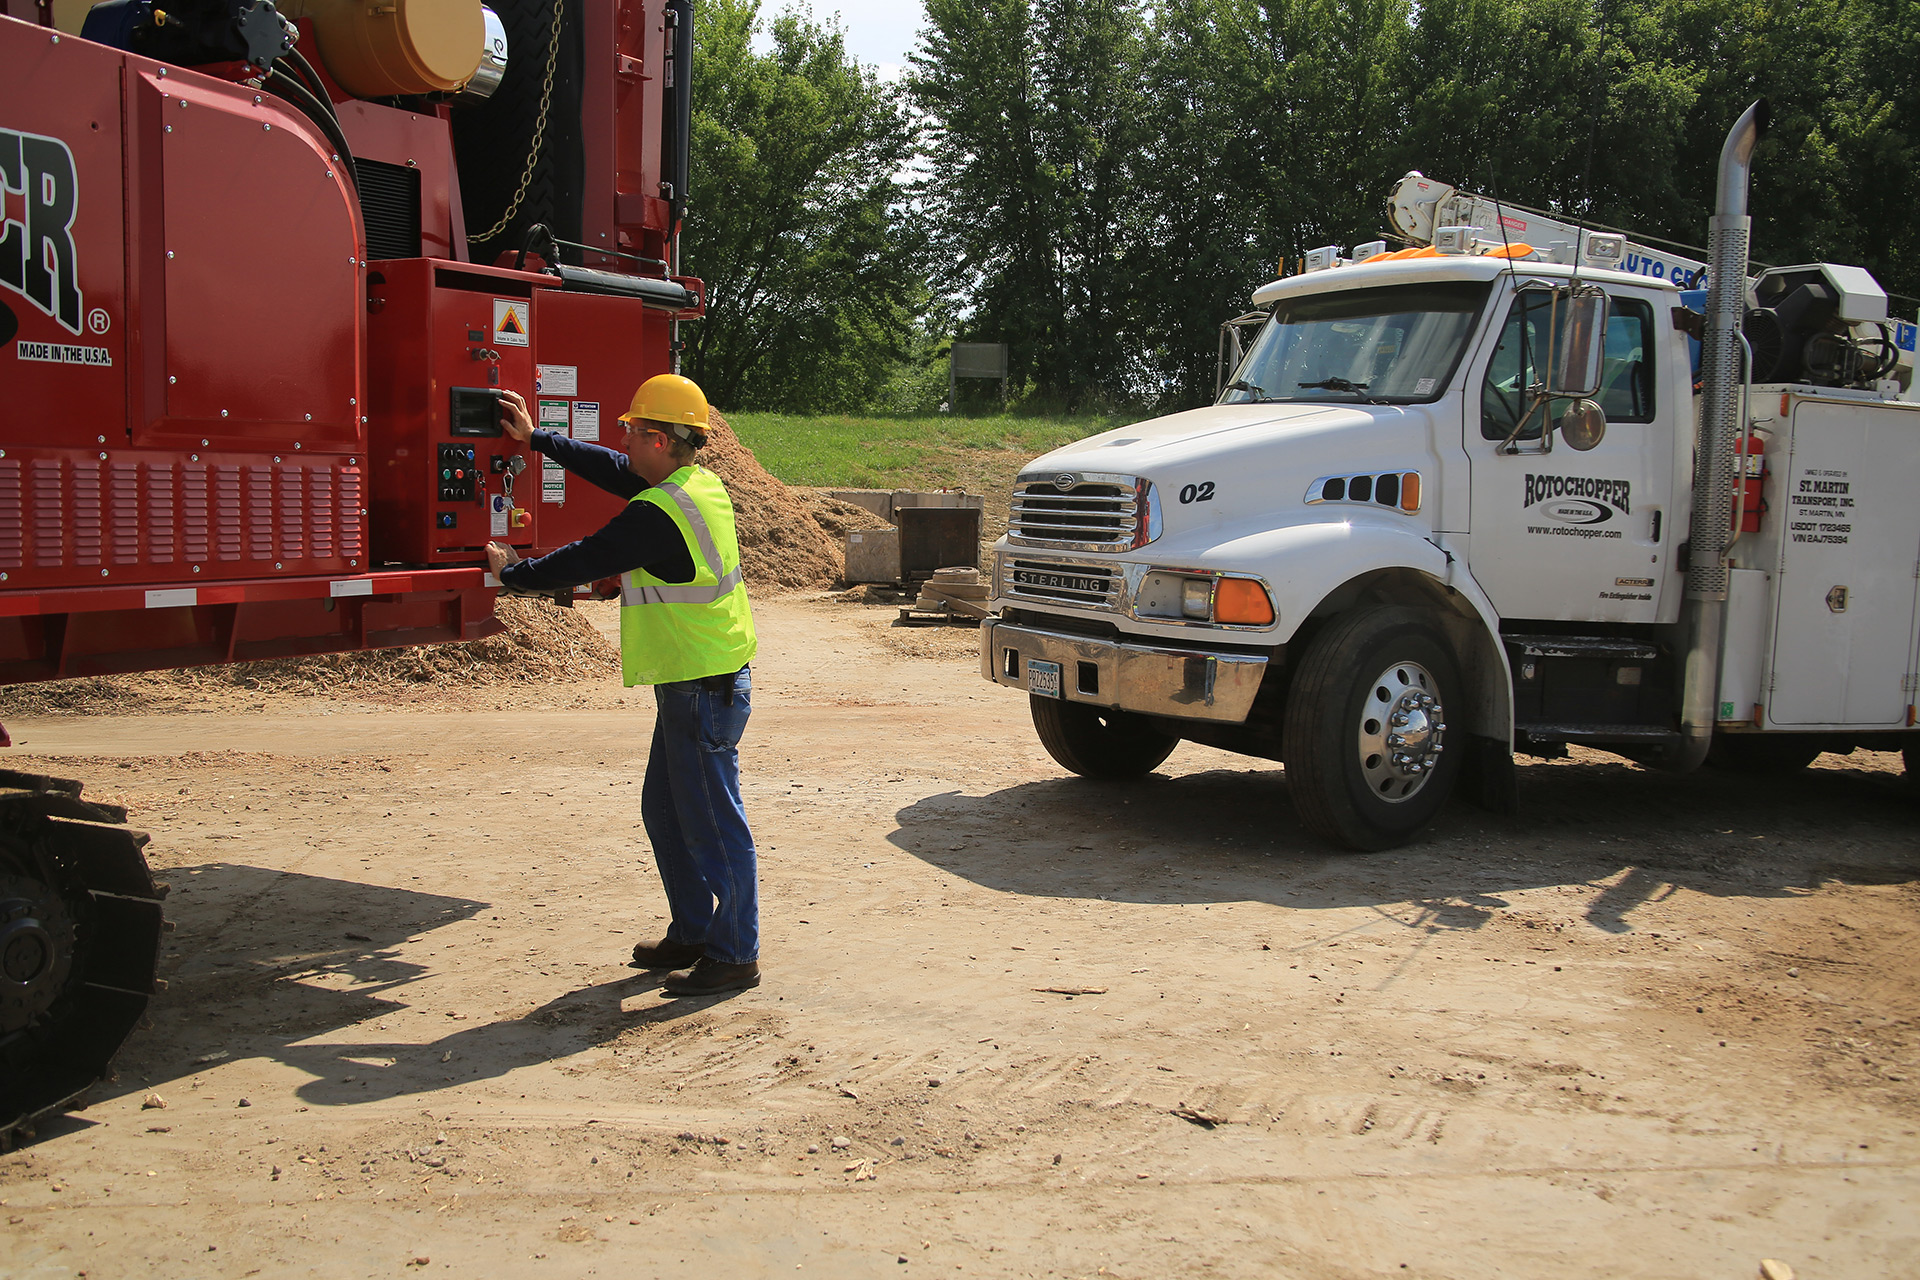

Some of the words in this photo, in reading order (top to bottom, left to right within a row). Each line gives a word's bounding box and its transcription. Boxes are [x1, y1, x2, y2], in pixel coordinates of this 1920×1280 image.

[19, 343, 49, 359] MADE
[51, 345, 62, 361] IN
[64, 347, 82, 362] THE
[85, 349, 111, 364] U.S.A.
[1179, 481, 1216, 505] 02
[1800, 480, 1812, 493] ST.
[1813, 480, 1850, 494] MARTIN
[1523, 473, 1631, 516] ROTOCHOPPER
[1792, 495, 1838, 508] TRANSPORT,
[1840, 498, 1855, 507] INC.
[1809, 509, 1834, 518] MARTIN,
[1527, 526, 1622, 539] www.rotochopper.com
[1790, 521, 1817, 531] USDOT
[1818, 523, 1852, 533] 1723465
[1792, 533, 1806, 543] VIN
[1019, 572, 1100, 591] STERLING
